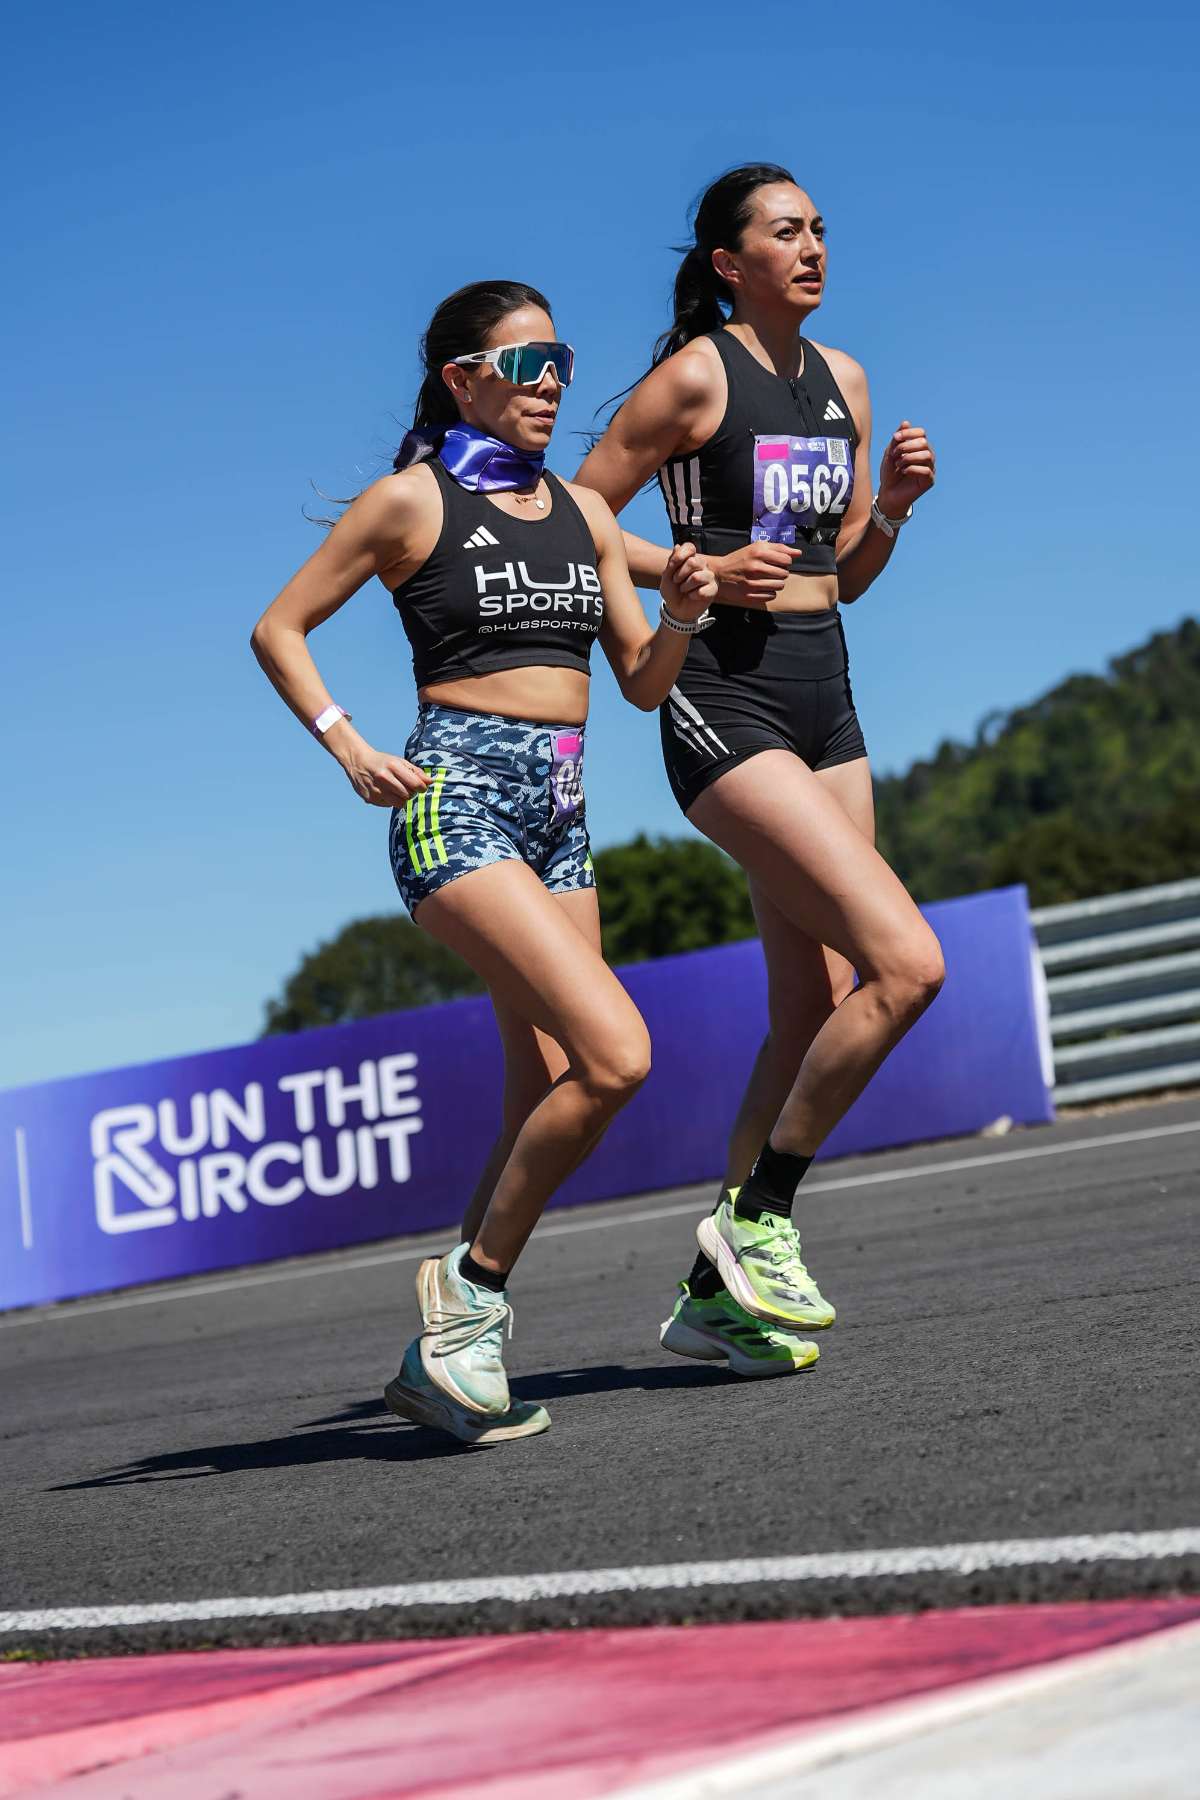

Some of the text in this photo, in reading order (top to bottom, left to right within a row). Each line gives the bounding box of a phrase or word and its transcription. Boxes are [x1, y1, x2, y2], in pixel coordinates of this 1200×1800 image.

[763, 463, 850, 514] 0562
[474, 561, 601, 593] HUB
[479, 592, 603, 616] SPORTS
[91, 1052, 422, 1175] RUN THE
[94, 1116, 424, 1235] CIRCUIT
